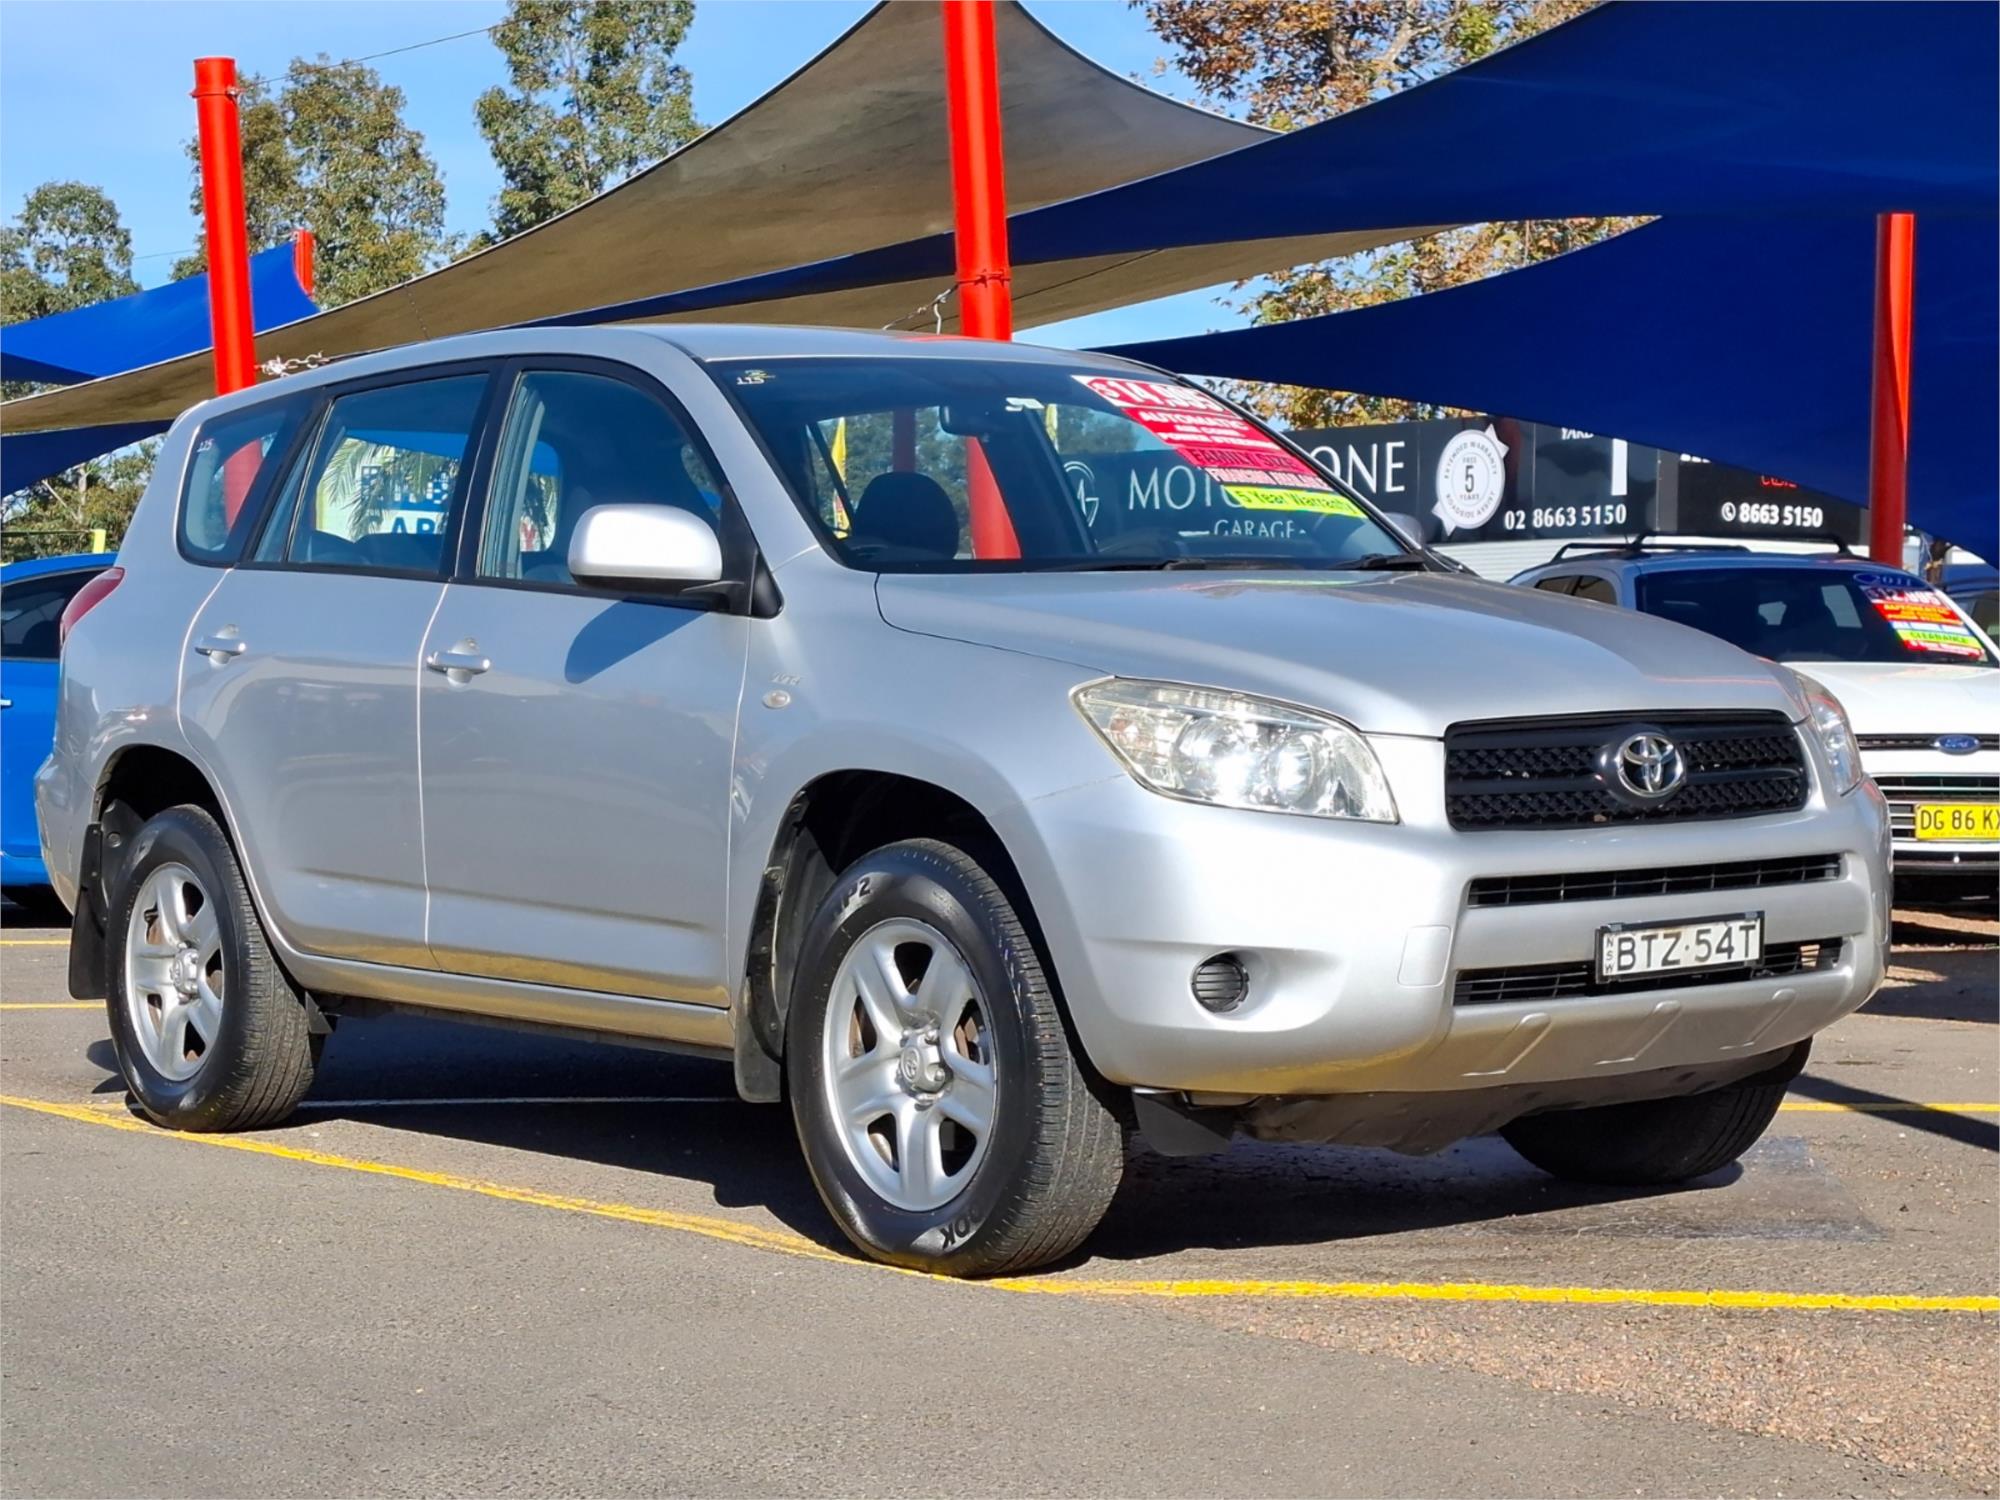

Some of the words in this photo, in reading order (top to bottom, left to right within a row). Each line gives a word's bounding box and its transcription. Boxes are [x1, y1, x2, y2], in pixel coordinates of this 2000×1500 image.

[1138, 411, 1249, 431] AUTOMATIC
[1190, 450, 1258, 468] FAMILY
[1464, 465, 1475, 493] 5
[1251, 491, 1288, 505] Year
[1504, 509, 1527, 530] 02
[1532, 506, 1577, 529] 8663
[1580, 503, 1627, 526] 5150
[1738, 502, 1780, 526] 8663
[1782, 505, 1824, 528] 5150
[1920, 809, 1945, 831] DG
[1951, 809, 1976, 831] 86
[1605, 936, 1614, 972] NSW
